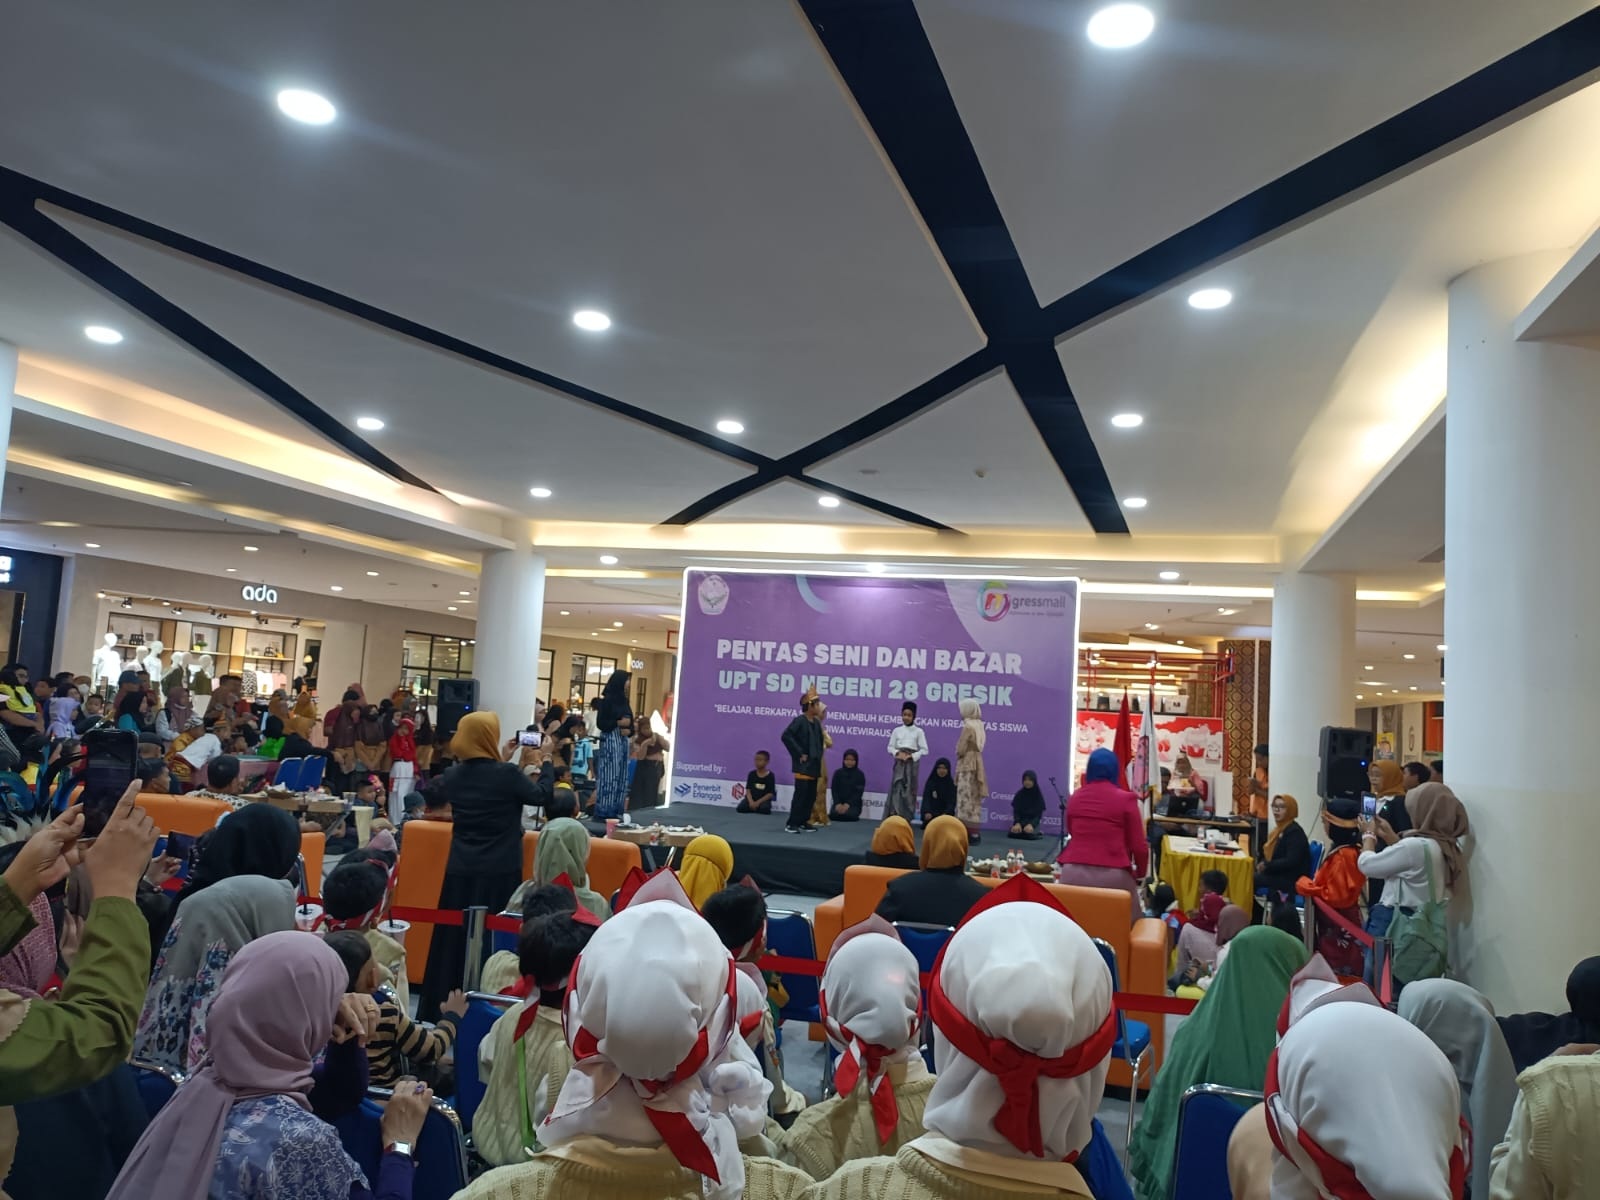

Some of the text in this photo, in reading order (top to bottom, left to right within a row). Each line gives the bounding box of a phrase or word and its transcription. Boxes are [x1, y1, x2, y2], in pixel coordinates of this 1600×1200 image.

[242, 584, 277, 603] ada
[1012, 595, 1066, 609] gressmall
[717, 638, 1022, 675] PENTAS SENI DAN BAZAR
[718, 670, 1013, 706] UPT SD NEGERI 28 GRESIK
[754, 706, 798, 717] BERKARYA
[826, 711, 876, 723] MENUMBUH
[878, 714, 940, 727] KEMBGKAN
[999, 722, 1029, 734] SISWA
[676, 761, 712, 773] Supported
[713, 763, 723, 775] by
[692, 783, 721, 792] Penerbit
[692, 791, 722, 802] Erlangga
